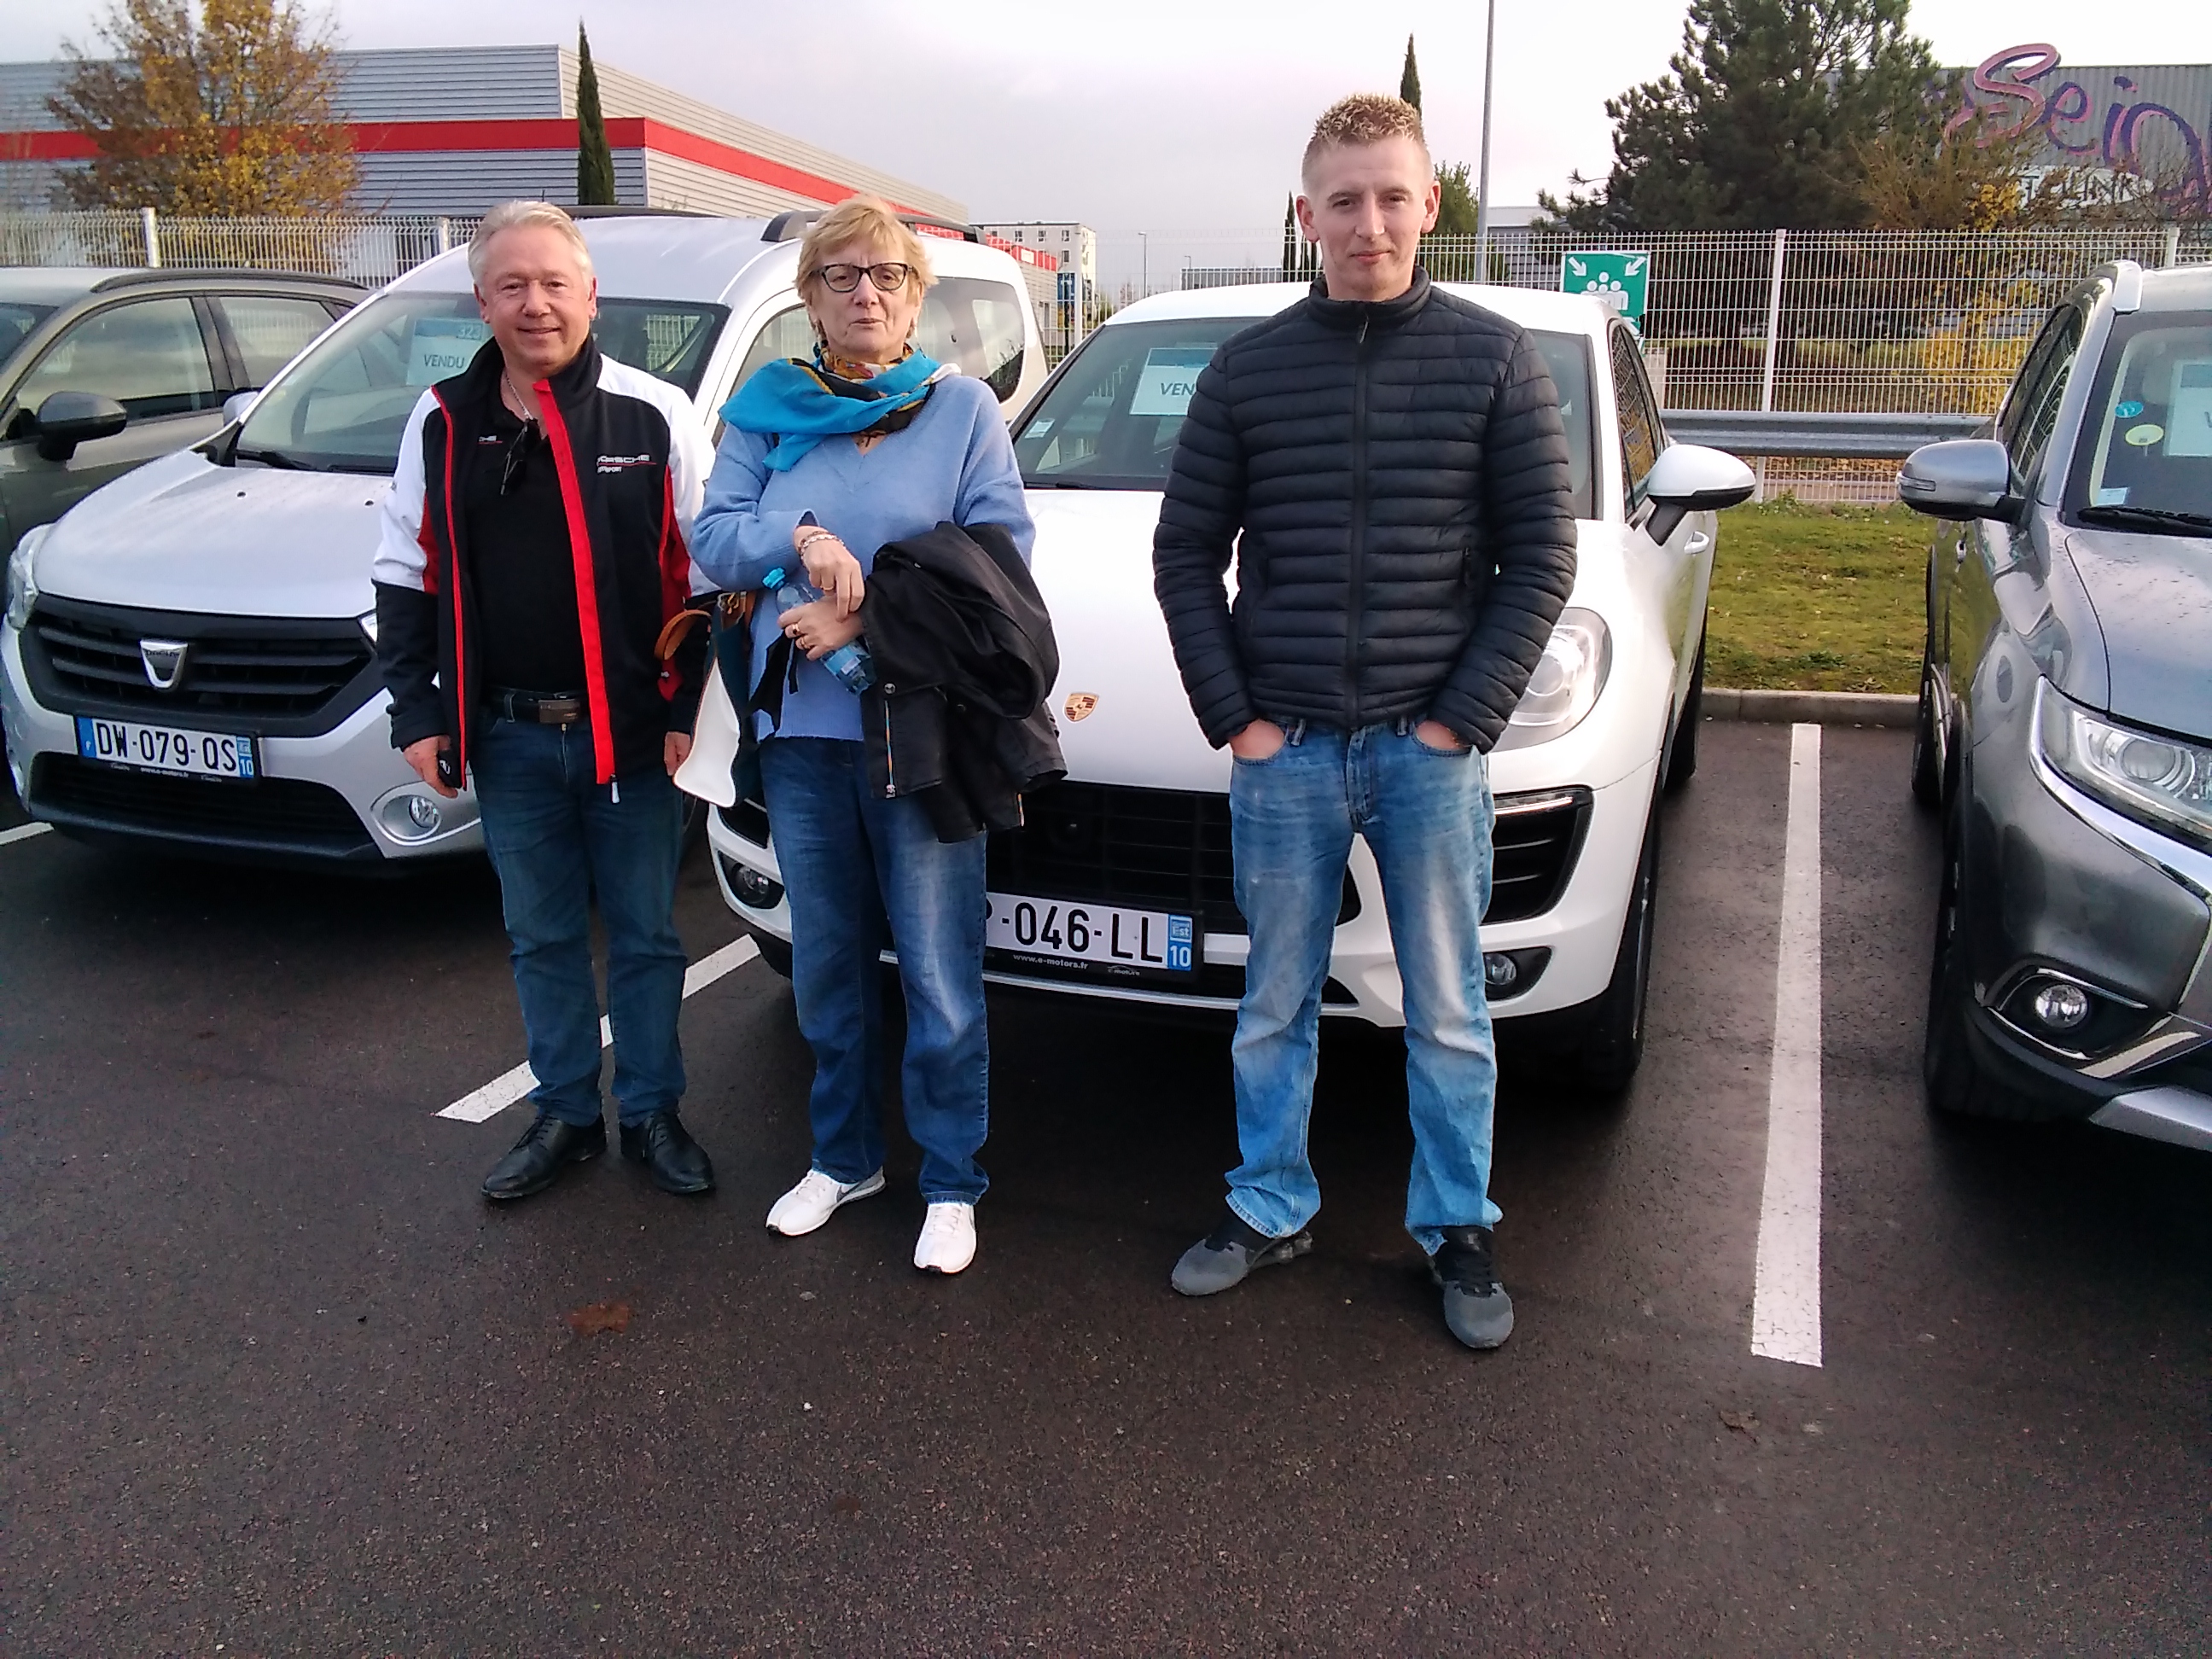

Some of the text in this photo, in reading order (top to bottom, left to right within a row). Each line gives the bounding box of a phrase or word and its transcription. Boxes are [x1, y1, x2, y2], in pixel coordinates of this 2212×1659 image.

[423, 354, 465, 368] VENDU
[1161, 382, 1196, 396] VEN
[96, 722, 237, 772] DW-079-QS
[240, 759, 254, 776] 10
[1013, 954, 1089, 969] www.e-motors.fr
[1170, 946, 1191, 968] 10
